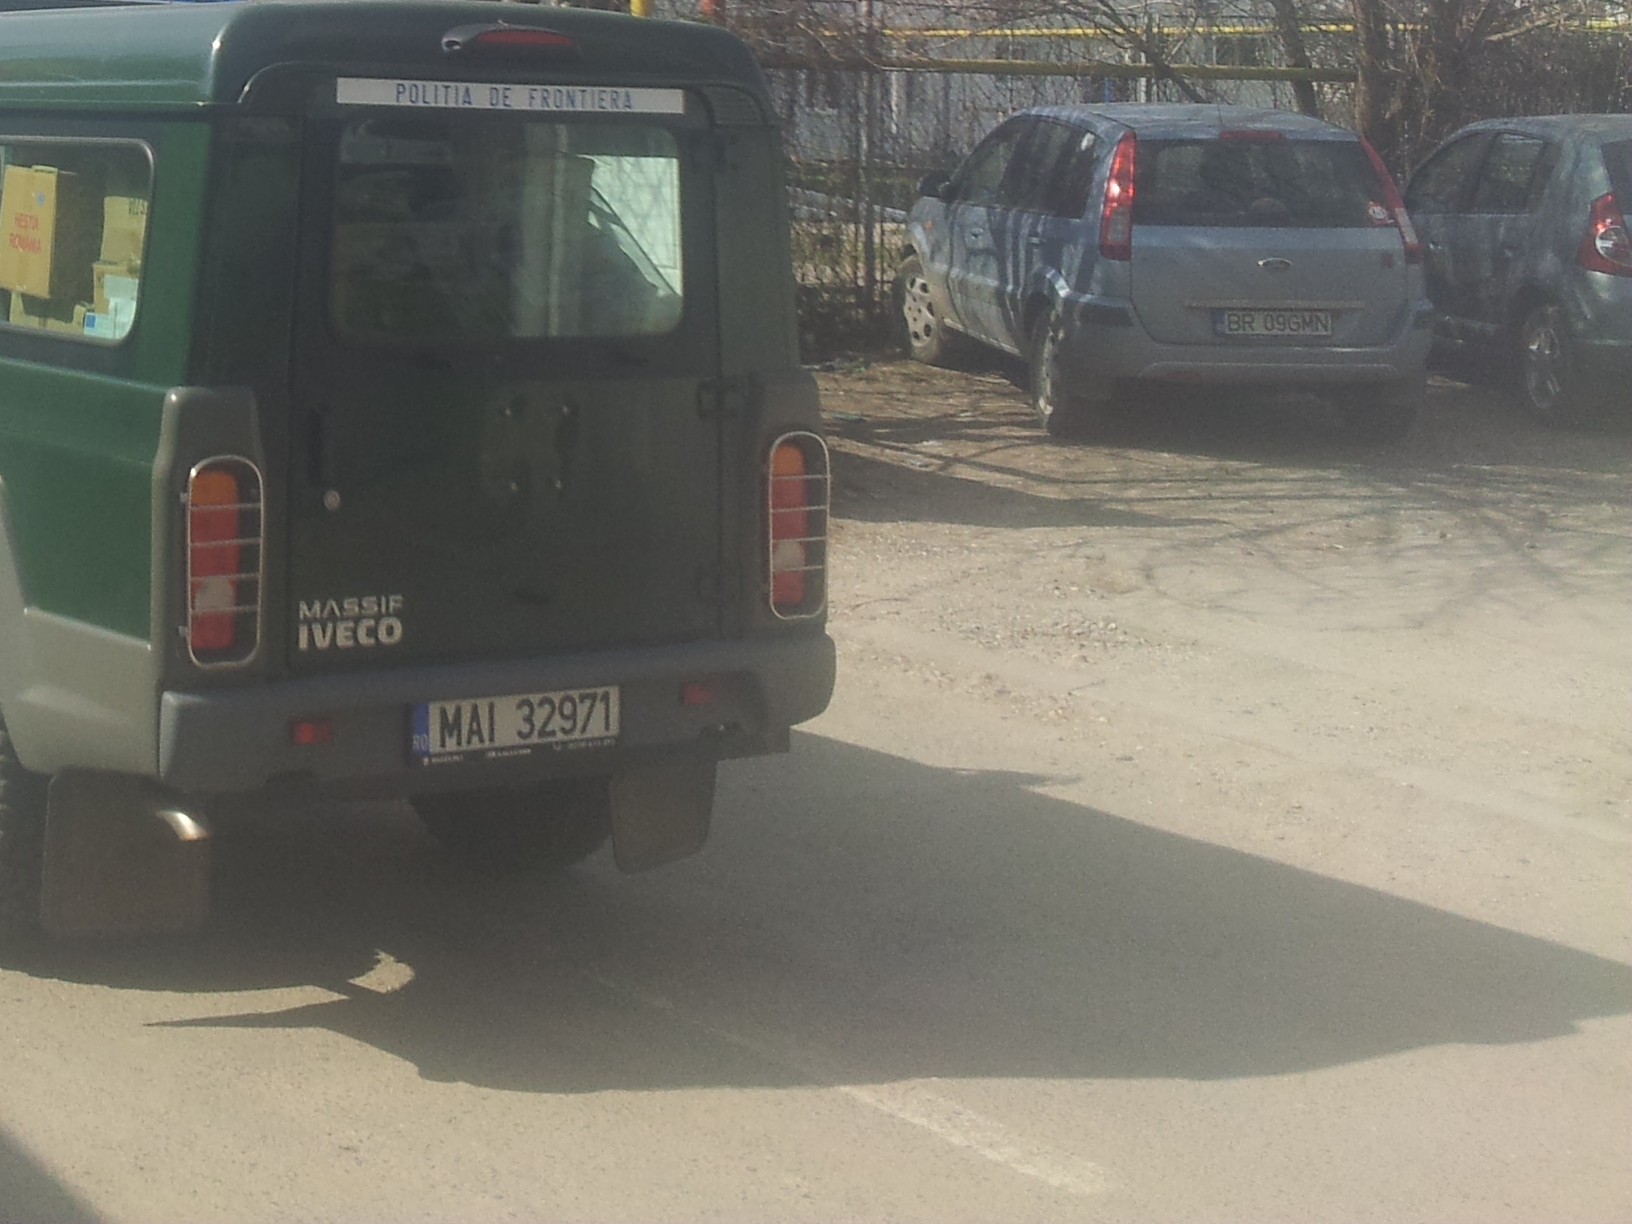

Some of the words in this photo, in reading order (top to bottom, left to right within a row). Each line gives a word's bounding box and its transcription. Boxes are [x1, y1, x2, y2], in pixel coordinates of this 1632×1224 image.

[395, 82, 473, 106] POLITIA
[489, 87, 513, 108] DE
[528, 88, 633, 110] FRONTIERA
[1227, 312, 1255, 332] BR
[1264, 312, 1330, 333] 09GMN
[298, 594, 404, 620] MASSIF
[298, 616, 404, 651] IVECO
[413, 733, 429, 752] RO
[438, 701, 496, 749] MAI
[515, 690, 612, 741] 32971
